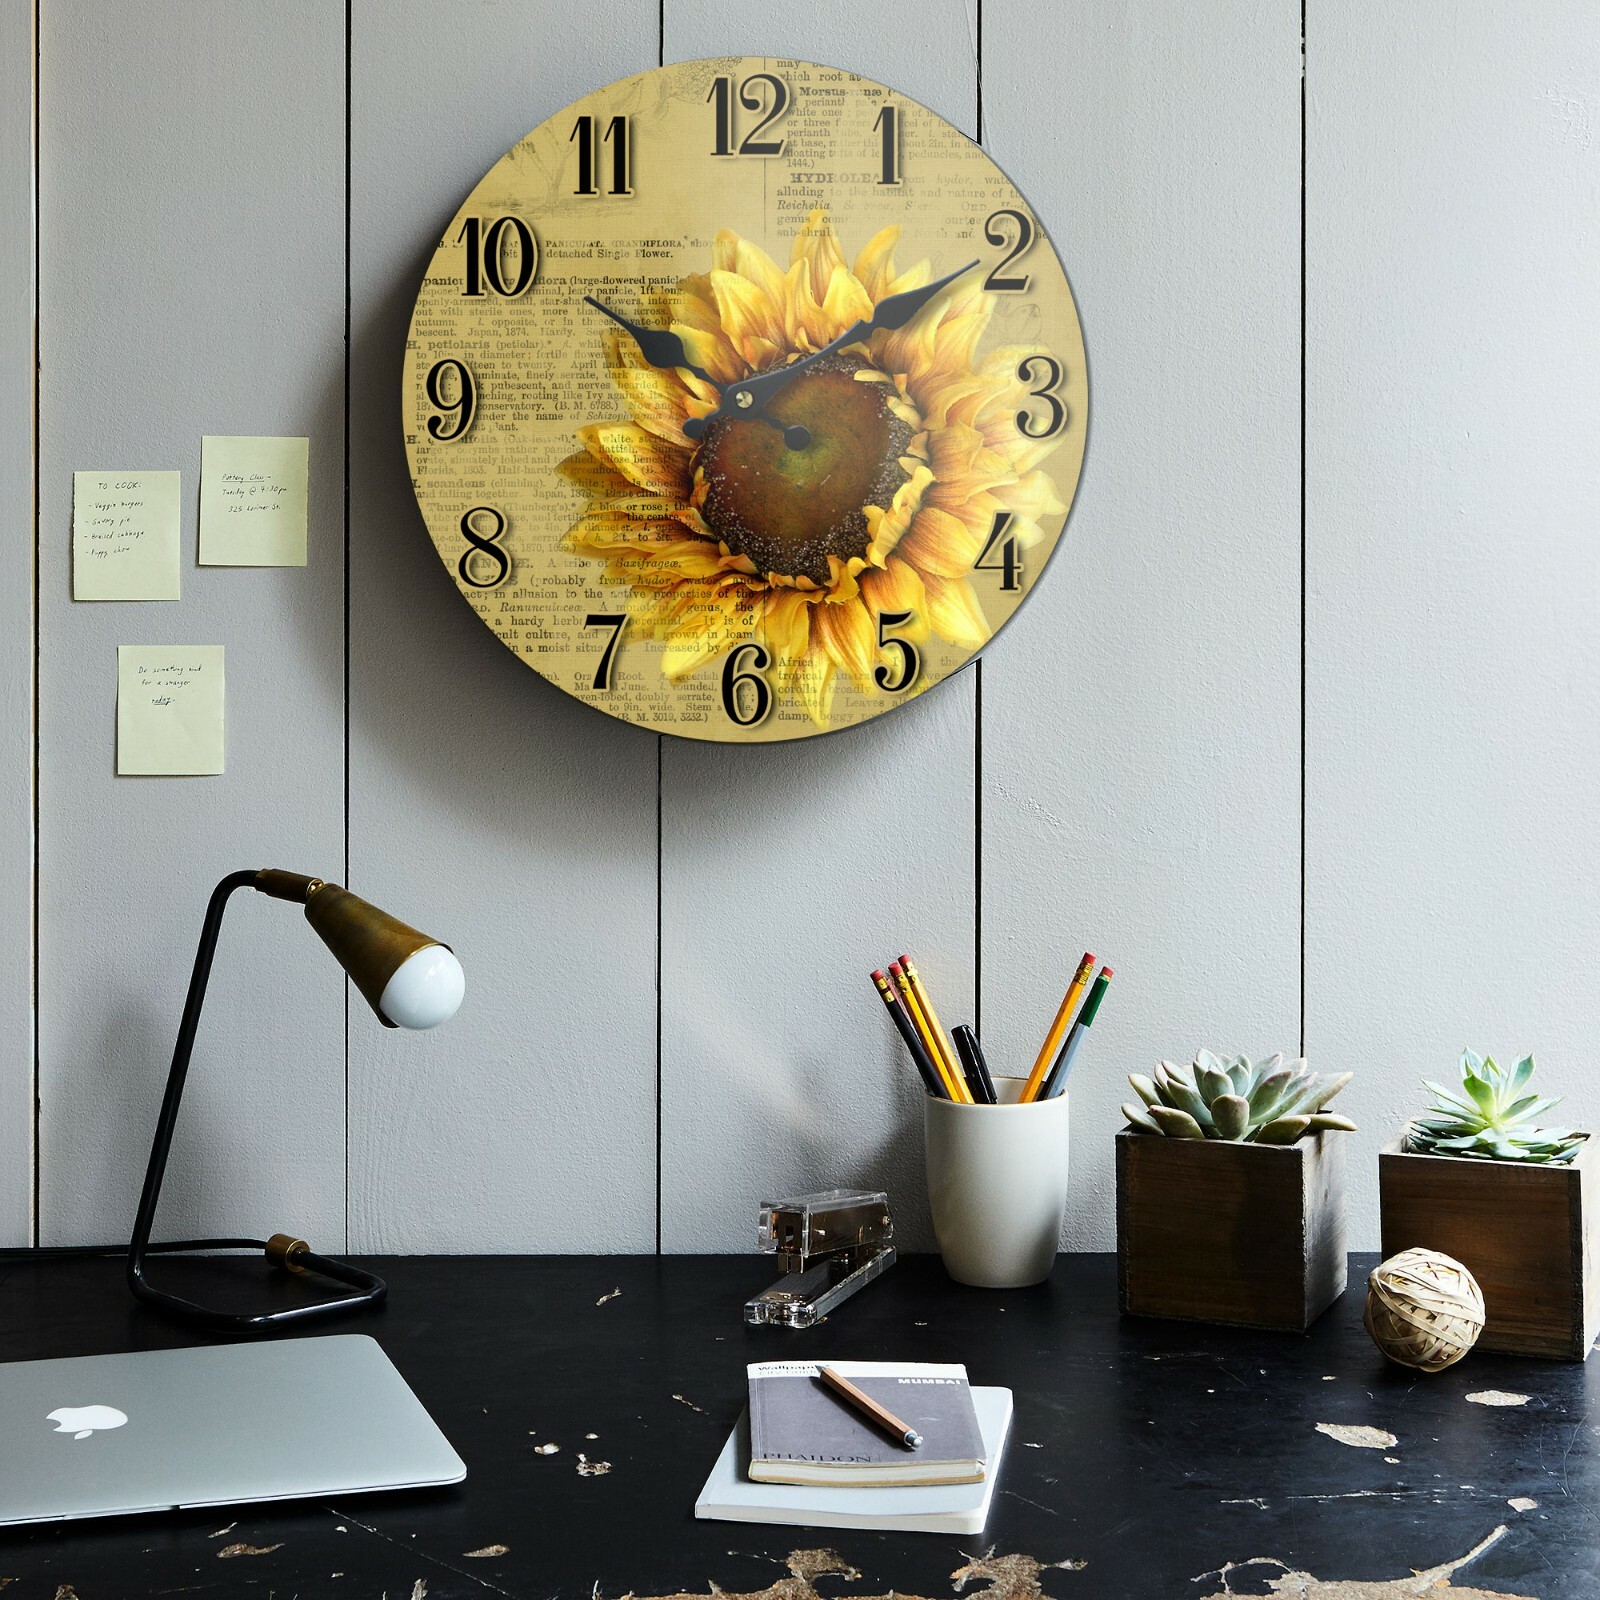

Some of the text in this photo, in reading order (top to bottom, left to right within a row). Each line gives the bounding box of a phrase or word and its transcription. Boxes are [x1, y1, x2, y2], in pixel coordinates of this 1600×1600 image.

[819, 72, 842, 81] root
[706, 74, 785, 155] 12
[804, 118, 830, 126] three
[787, 128, 830, 138] perianth
[873, 106, 900, 185] 1
[569, 116, 631, 195] 11
[909, 150, 961, 160] peduncles,
[787, 159, 814, 168] 1444.)
[777, 186, 824, 197] alluding
[777, 200, 833, 211] Reichelia,
[777, 214, 810, 225] genus
[546, 249, 673, 260] detached Single Flower.
[985, 209, 1031, 291] 2
[457, 216, 535, 297] 10
[570, 276, 645, 285] (large-flowered
[596, 287, 636, 296] panicle,
[605, 296, 643, 306] flowers,
[510, 309, 535, 317] ones,
[492, 318, 537, 328] opposite,
[563, 317, 573, 325] in
[416, 328, 456, 336] bescent.
[468, 328, 502, 338] Japan,
[506, 328, 529, 336] 1874.
[428, 339, 610, 350] petiolaris white,
[518, 362, 555, 371] twenty.
[571, 360, 597, 370] April
[603, 360, 622, 368] and
[526, 370, 628, 381] finely serrate, dark
[491, 382, 546, 391] pubescent,
[618, 381, 658, 389] bearded
[426, 358, 474, 441] 9
[522, 391, 646, 401] rooting like Ivy against
[1016, 355, 1064, 438] 3
[478, 402, 618, 411] conservatory. M. 6788.)
[513, 412, 529, 420] the
[570, 411, 580, 420] of
[501, 455, 550, 464] lobed and
[427, 478, 605, 489] scandens (climbing). white;
[476, 489, 521, 499] together.
[533, 490, 567, 499] Japan,
[571, 488, 594, 497] 1879.
[606, 488, 633, 497] Plant
[636, 488, 681, 498] climbing
[600, 502, 622, 510] blue
[642, 503, 668, 511] rose;
[674, 502, 691, 510] the
[627, 512, 644, 520] the
[647, 513, 682, 521] centre,
[458, 506, 508, 588] 8
[521, 544, 545, 553] 1870,
[974, 512, 1021, 591] 4
[598, 559, 609, 567] of
[599, 576, 625, 584] from
[637, 576, 673, 586] hydor,
[732, 576, 754, 584] and
[495, 589, 754, 600] in allusion the properties of the
[686, 604, 723, 613] genus,
[735, 602, 753, 611] the
[511, 616, 753, 627] hardy It is of
[526, 629, 753, 640] culture, and grown in loam
[538, 642, 720, 654] moist Increased by
[584, 613, 627, 689] 7
[875, 611, 917, 692] 5
[778, 672, 822, 681] tropical
[722, 643, 769, 726] 6
[677, 694, 715, 702] serrate,
[624, 702, 642, 711] 9in.
[650, 702, 675, 711] wide.
[686, 702, 711, 711] Stem
[778, 712, 812, 722] damp,
